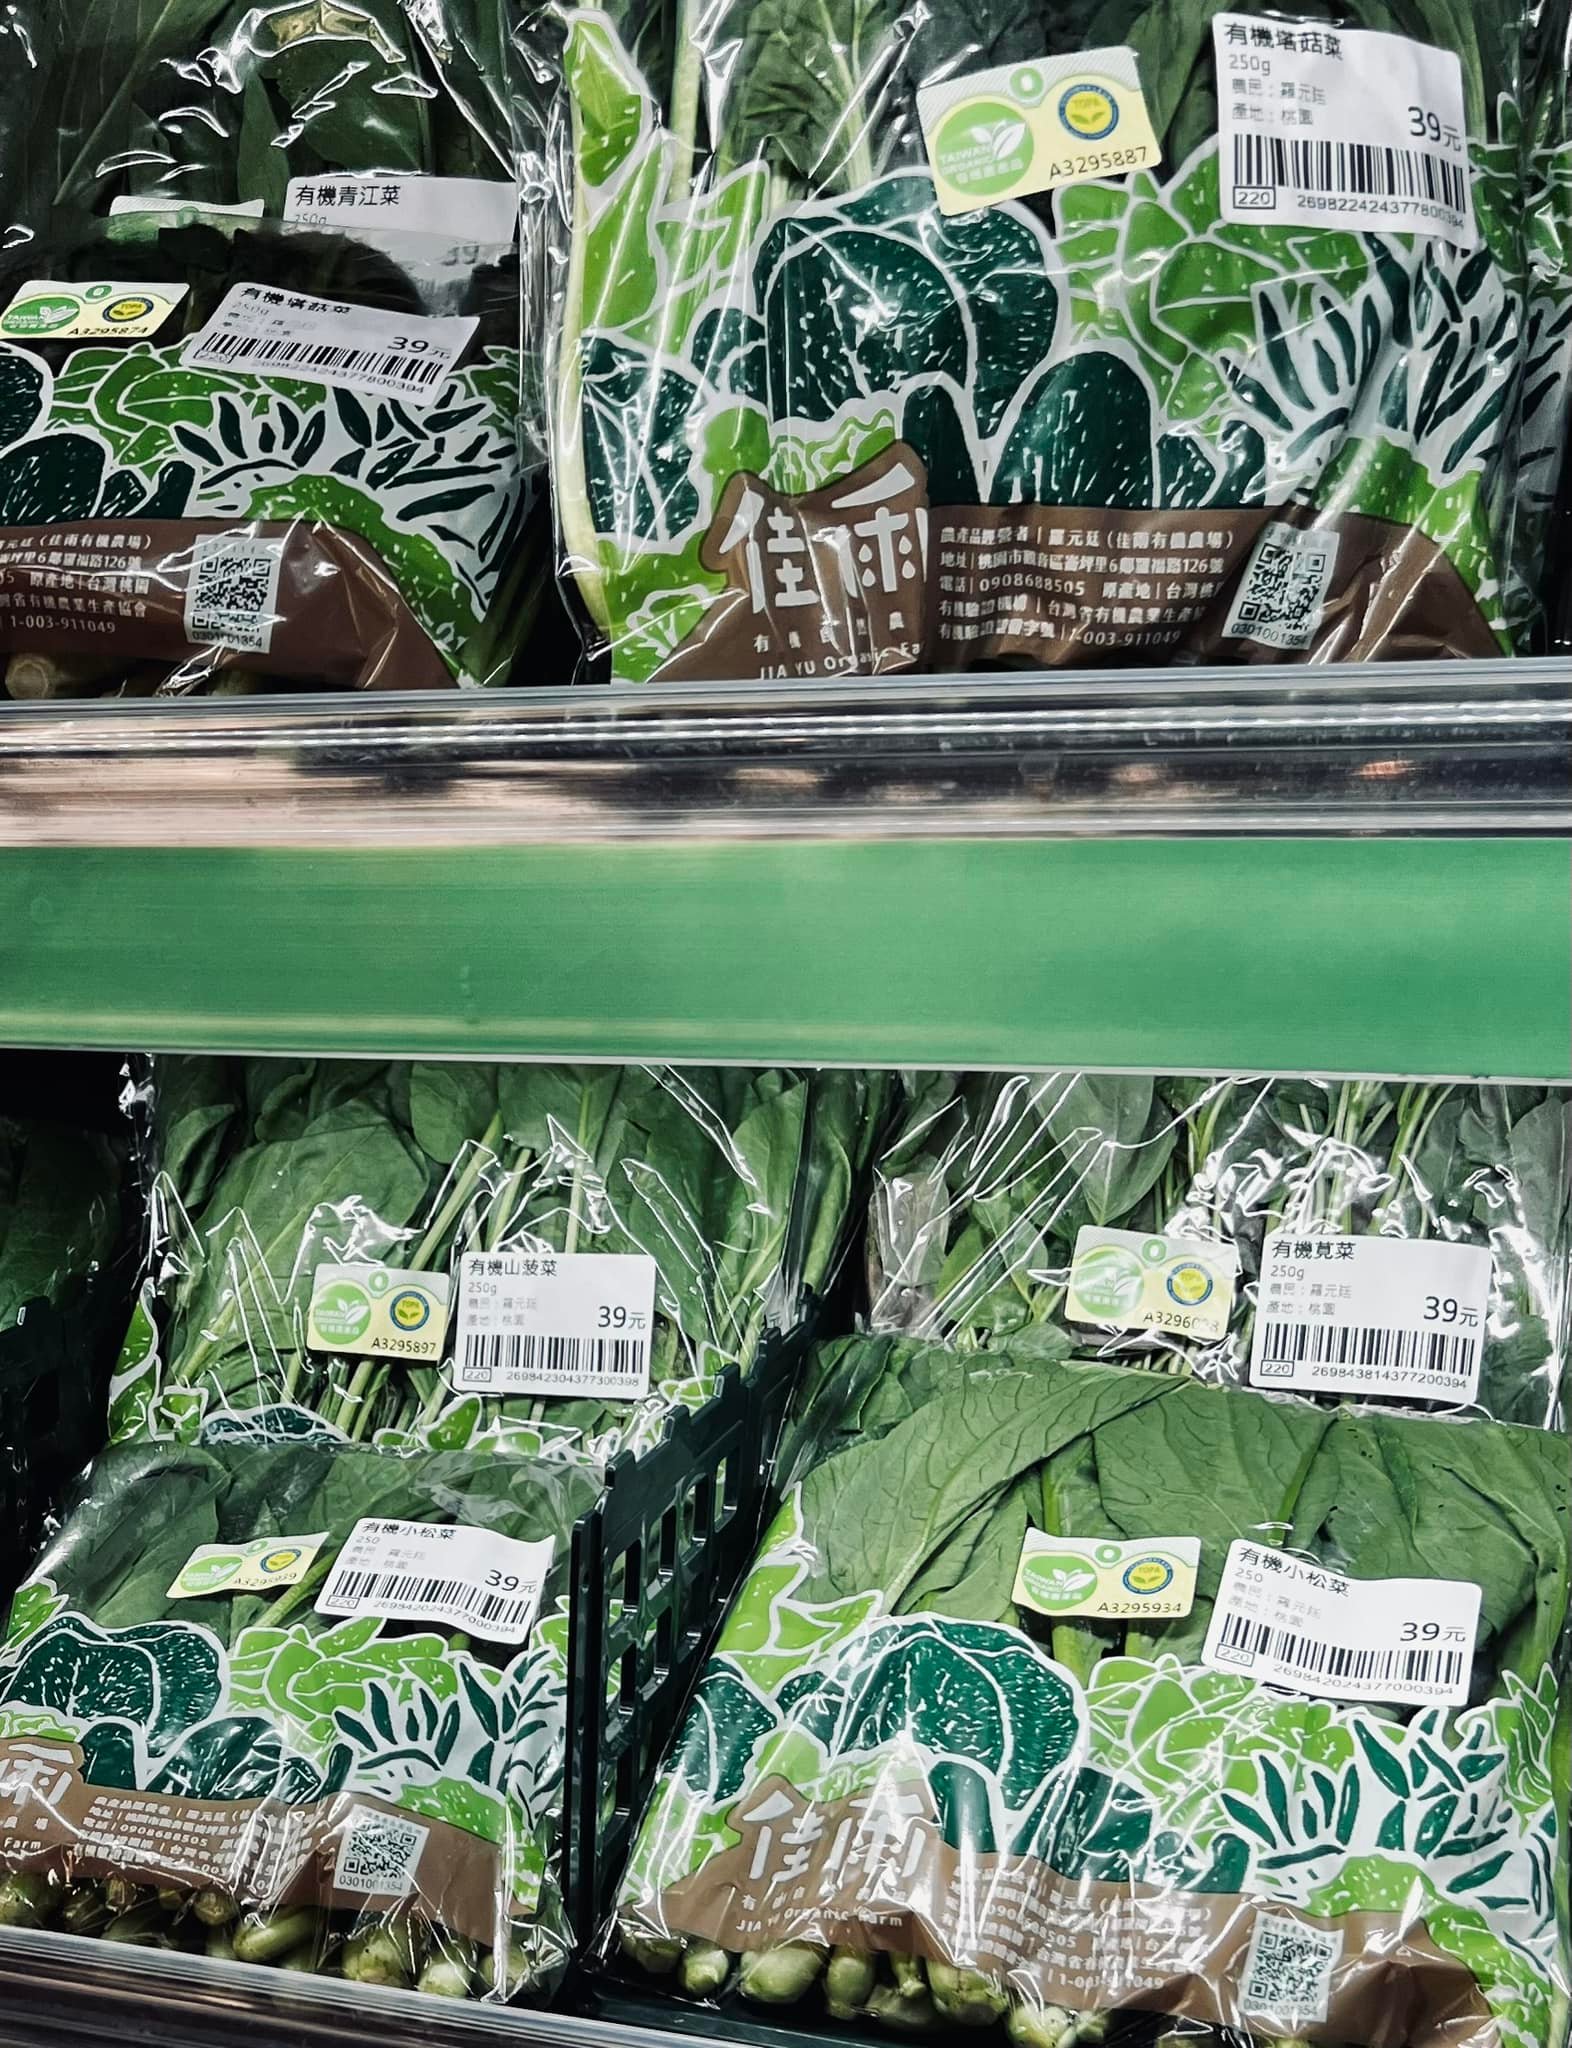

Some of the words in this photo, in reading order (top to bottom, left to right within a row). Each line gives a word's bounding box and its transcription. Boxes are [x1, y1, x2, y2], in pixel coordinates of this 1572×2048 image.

[1229, 54, 1272, 76] 250g
[1407, 106, 1462, 151] 39元
[1049, 146, 1148, 180] A3295887
[294, 184, 401, 207] 有機青江菜
[1237, 191, 1271, 206] 220
[387, 336, 451, 361] 39元
[1271, 1239, 1357, 1261] 有機莧菜
[468, 1258, 558, 1277] 有機山菠菜
[1270, 1264, 1305, 1280] 250g
[467, 1281, 498, 1296] 250g
[597, 1305, 647, 1330] 39元
[1423, 1295, 1480, 1328] 39元
[370, 1337, 437, 1354] A3295897
[1264, 1364, 1291, 1375] 220
[1311, 1365, 1468, 1390] 269843814377200394
[355, 1535, 381, 1545] 250
[362, 1521, 457, 1541] 有機小松菜
[484, 1568, 538, 1594] 39元
[1234, 1567, 1264, 1584] 250
[1238, 1547, 1352, 1598] 有機小松菜
[1097, 1601, 1183, 1614] A3295934
[1400, 1622, 1467, 1643] 39元
[1219, 1648, 1251, 1664] 220
[3, 1837, 42, 1849] Farm
